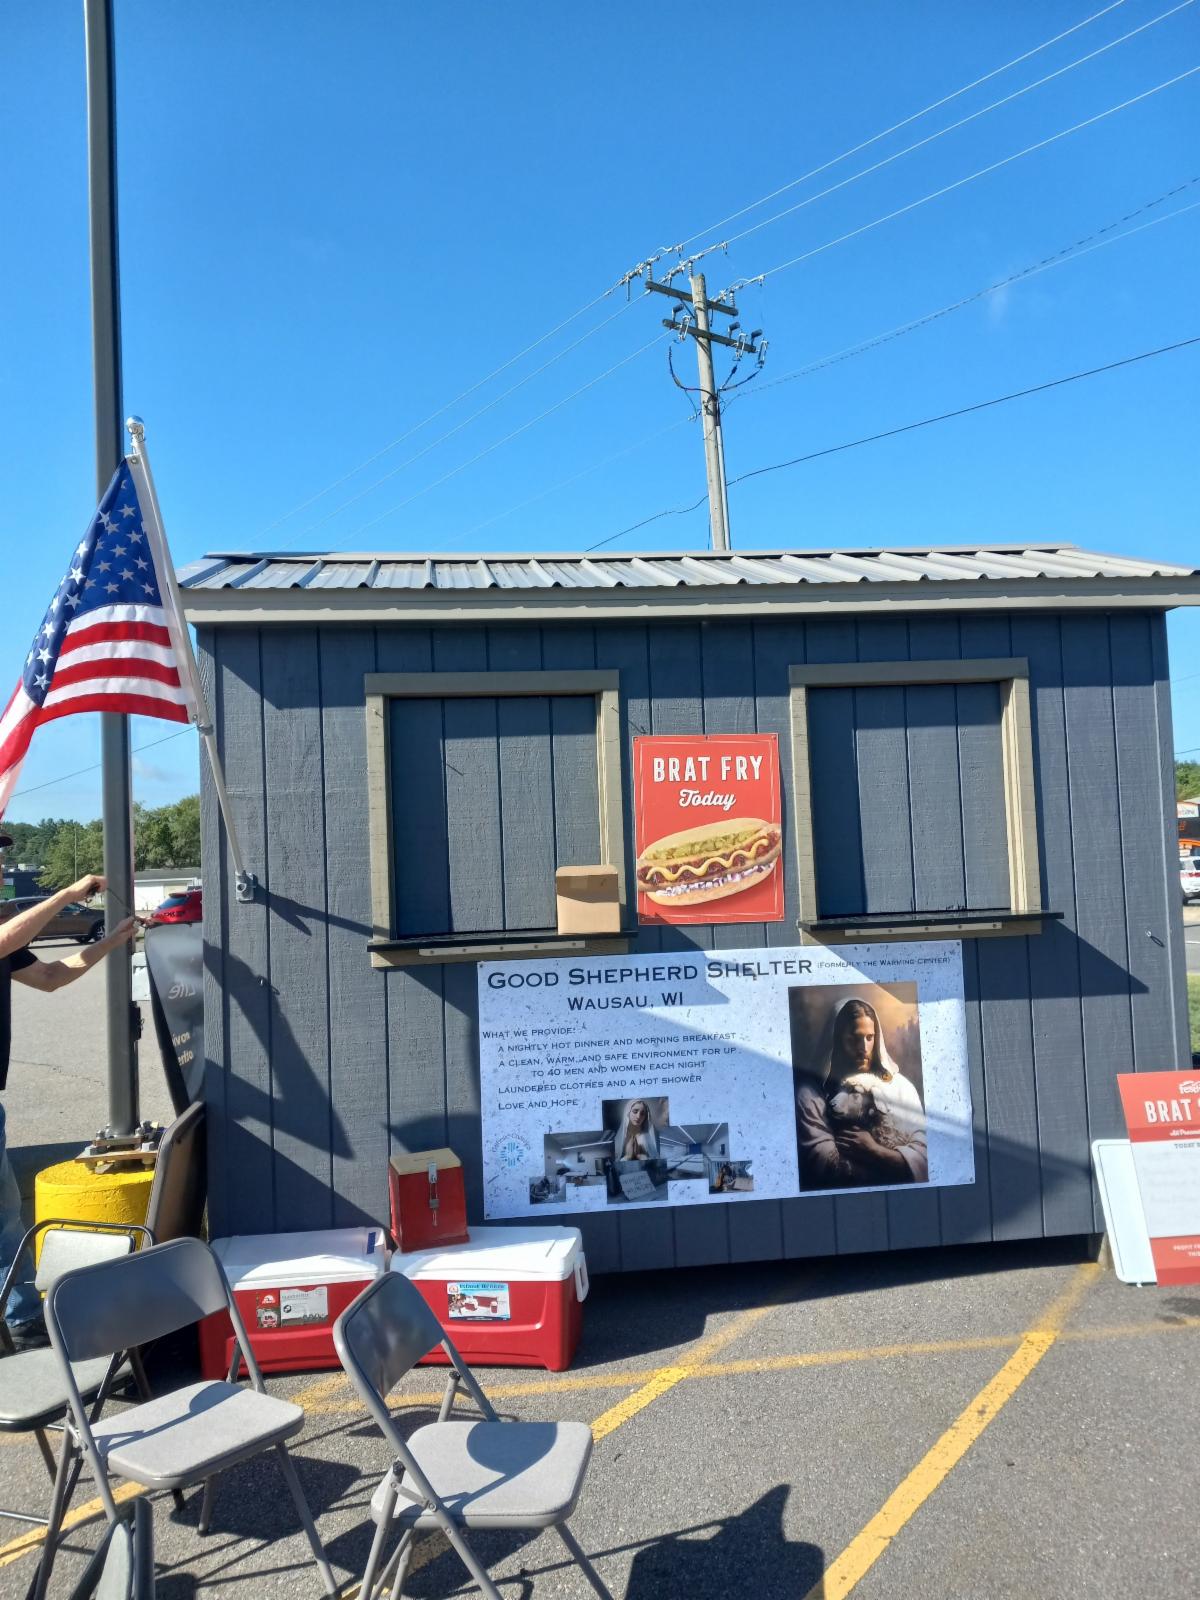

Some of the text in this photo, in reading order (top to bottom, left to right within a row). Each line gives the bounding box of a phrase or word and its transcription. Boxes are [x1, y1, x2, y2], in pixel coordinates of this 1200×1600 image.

[653, 755, 763, 782] BRAT FRY
[679, 788, 736, 811] Today
[488, 972, 559, 989] GOOD
[568, 965, 698, 985] SHEPHERD
[707, 959, 812, 978] SHELTER
[817, 961, 861, 969] (FORMERLY
[880, 958, 915, 967] WARMING
[917, 956, 951, 965] CENTER)
[567, 991, 683, 1011] WAUSAU, WI
[483, 1027, 576, 1039] WHAT WE PROVIDE:
[507, 1043, 548, 1052] NIGHTLY
[551, 1041, 571, 1049] HOT
[574, 1040, 610, 1048] DINNER
[613, 1038, 633, 1046] AND
[636, 1036, 680, 1044] MORNING
[682, 1032, 736, 1042] BREAKFAST
[508, 1058, 543, 1067] CLEAN,
[579, 1054, 602, 1062] AND
[604, 1053, 628, 1061] SAFE
[631, 1049, 699, 1059] ENVIRONMENT
[723, 1047, 737, 1055] UP
[547, 1068, 561, 1076] 40
[587, 1065, 608, 1074] AND
[610, 1064, 646, 1073] WOMEN
[649, 1062, 675, 1070] EACH
[677, 1060, 707, 1068] NIGHT
[498, 1084, 557, 1094] LAUNDERED
[559, 1081, 604, 1090] CLOTHES
[606, 1079, 627, 1087] AND
[661, 1075, 702, 1084] SHOWER
[498, 1102, 525, 1110] LOVE
[551, 1099, 578, 1107] HOPE
[1144, 1098, 1192, 1123] BRAT
